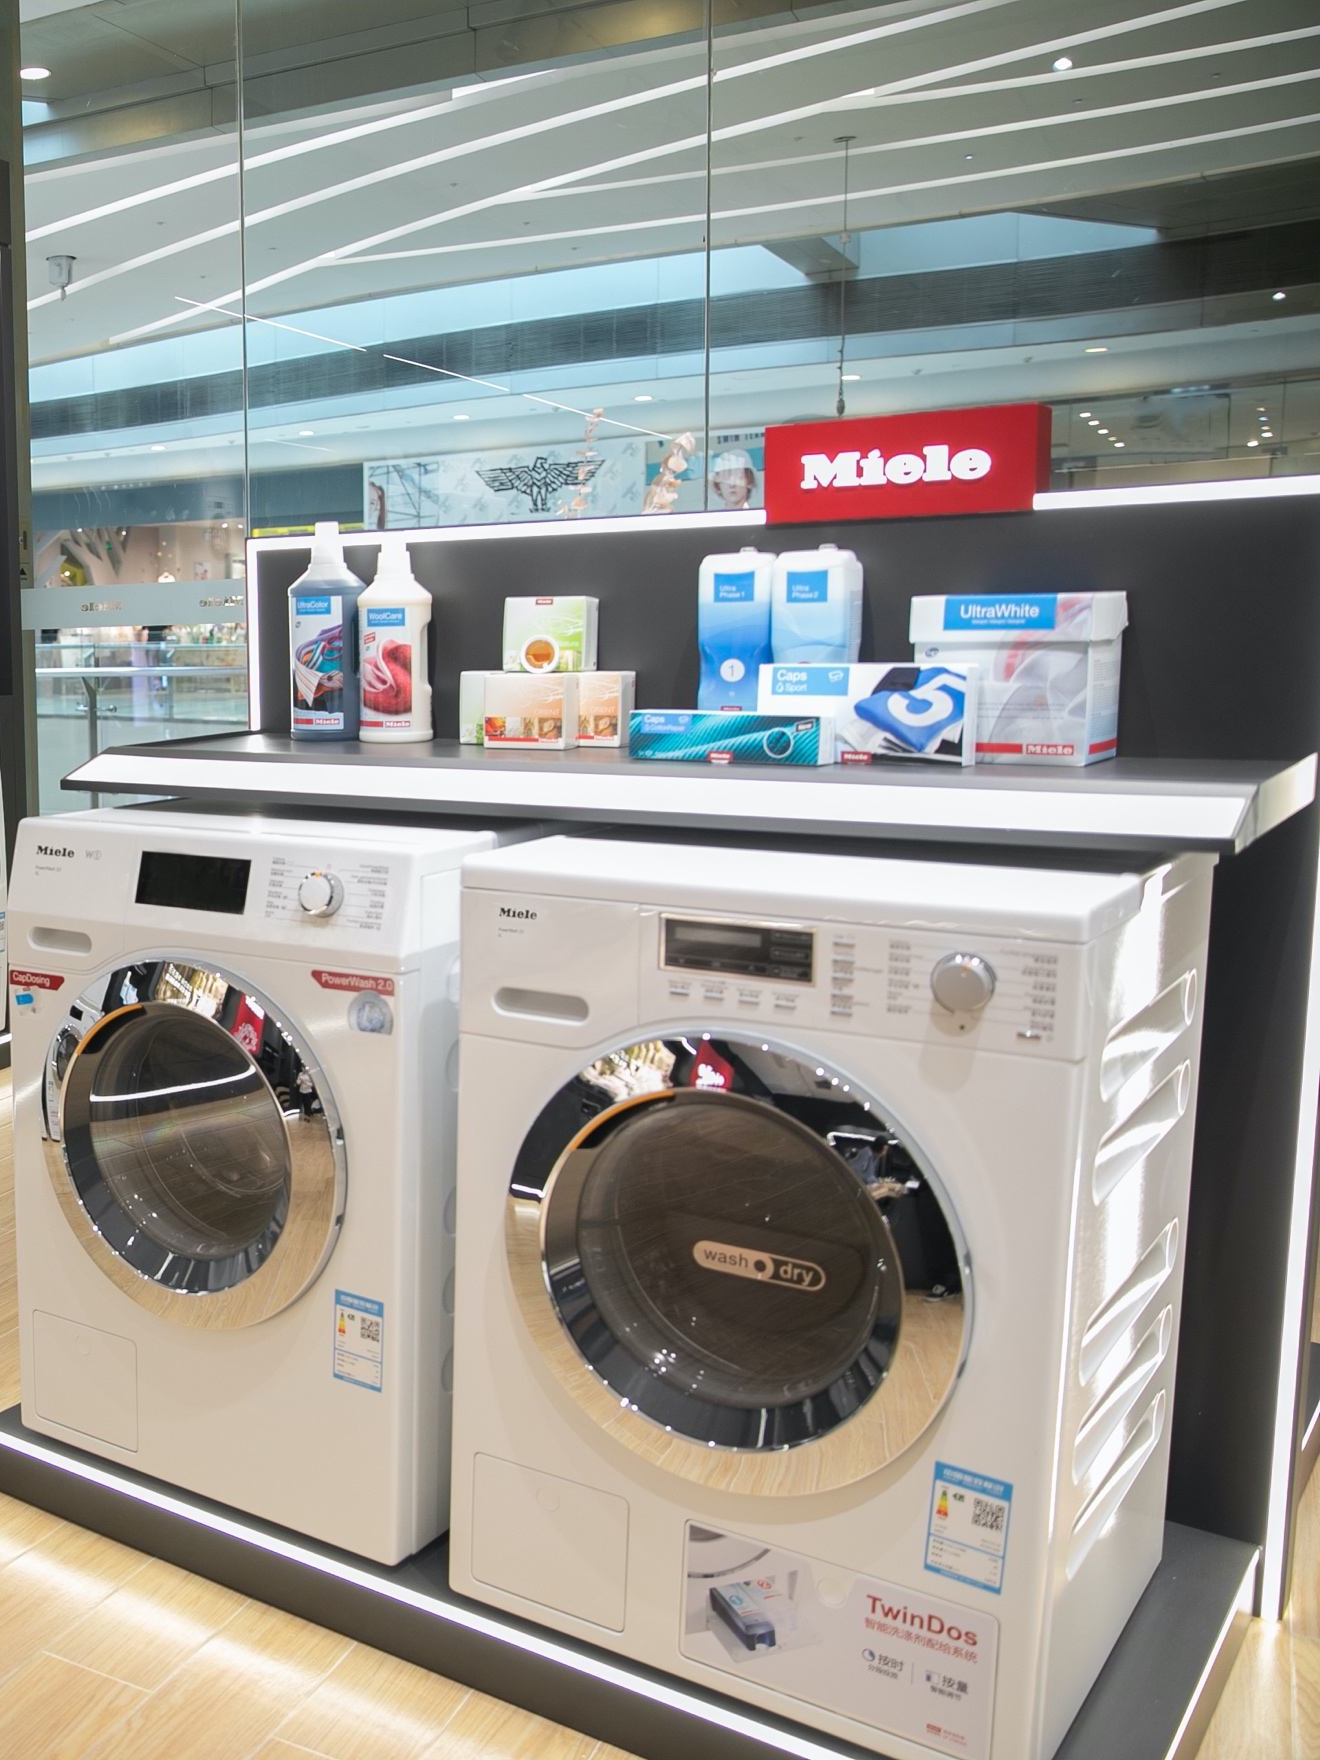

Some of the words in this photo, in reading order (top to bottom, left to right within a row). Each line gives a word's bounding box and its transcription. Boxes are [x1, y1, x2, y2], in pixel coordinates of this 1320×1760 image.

[800, 444, 992, 490] Miele
[959, 603, 1040, 619] UltraWhite
[777, 669, 808, 683] Caps
[784, 684, 808, 693] Sport
[1027, 745, 1073, 755] Miele
[35, 844, 76, 859] Miele
[498, 906, 538, 921] Miele
[12, 972, 51, 988] CapDosing
[321, 972, 377, 990] PowerWash
[377, 978, 393, 991] 2.0
[703, 1248, 749, 1269] wash
[779, 1262, 814, 1287] dry
[866, 1593, 979, 1648] TwinDos
